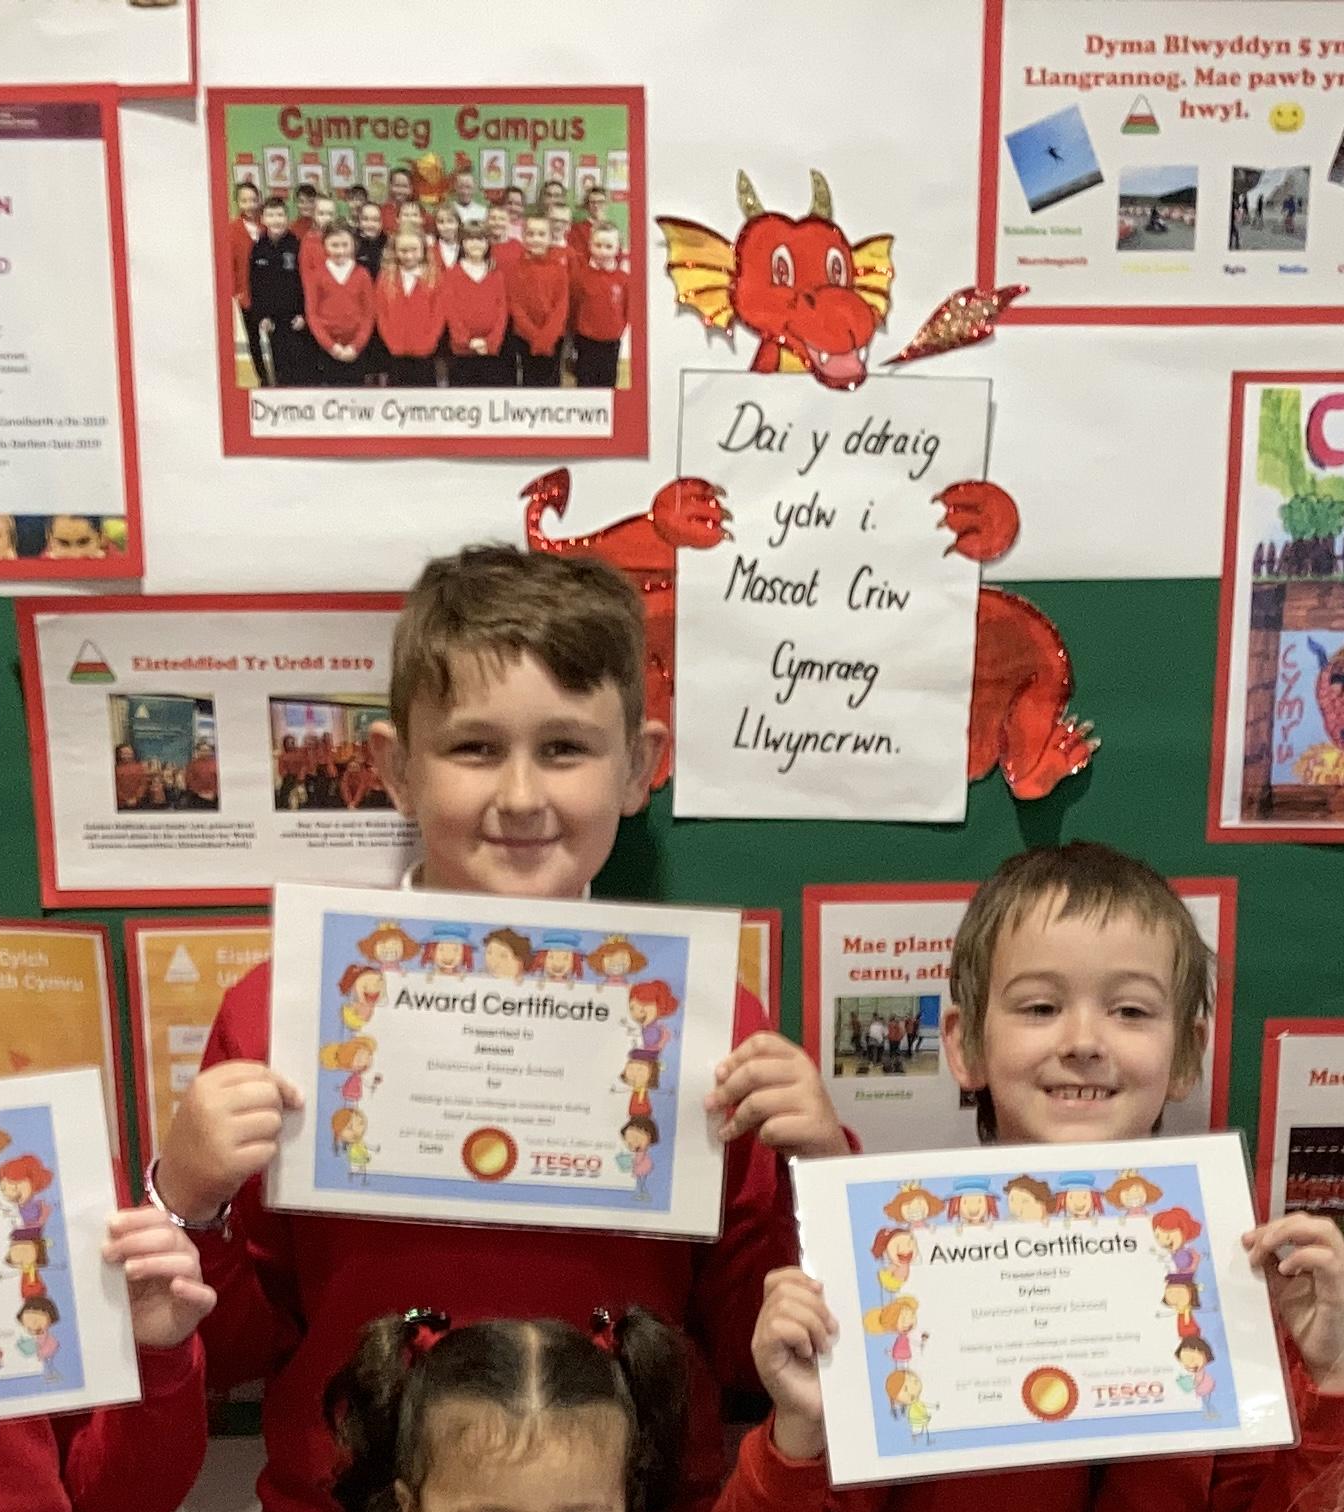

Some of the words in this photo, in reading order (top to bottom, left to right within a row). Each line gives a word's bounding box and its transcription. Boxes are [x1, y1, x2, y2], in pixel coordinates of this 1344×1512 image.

[1085, 36, 1156, 59] Dyma
[1163, 34, 1291, 59] Blwyddyn
[1298, 39, 1311, 56] 5
[1024, 67, 1186, 90] Llangrannog.
[1195, 67, 1241, 88] Mae
[1248, 67, 1316, 91] pawb
[1179, 100, 1249, 122] hwyl.
[279, 106, 431, 149] Cymraeg
[455, 107, 585, 149] Campus
[251, 399, 315, 422] Dyma
[322, 399, 375, 421] Criw
[381, 399, 482, 427] Cymraeg
[489, 400, 608, 426] Llwyncrwn
[718, 401, 793, 453] Dai
[797, 429, 829, 475] y
[768, 491, 837, 547] ydw
[724, 556, 819, 608] Mascot
[848, 565, 910, 612] Criw
[244, 655, 267, 671] Yr
[273, 655, 324, 671] Urdd
[329, 657, 375, 670] 2019
[771, 640, 880, 709] Cymraeg
[732, 706, 901, 774] Llwyncrwn.
[842, 935, 886, 953] Mae
[894, 935, 954, 956] plant
[849, 967, 910, 983] canu,
[394, 986, 477, 1015] Award
[482, 992, 610, 1022] Certificate
[529, 1151, 603, 1172] TESCO
[929, 1239, 1009, 1266] Award
[1014, 1232, 1138, 1259] Certificate
[1092, 1380, 1165, 1402] TESCO
